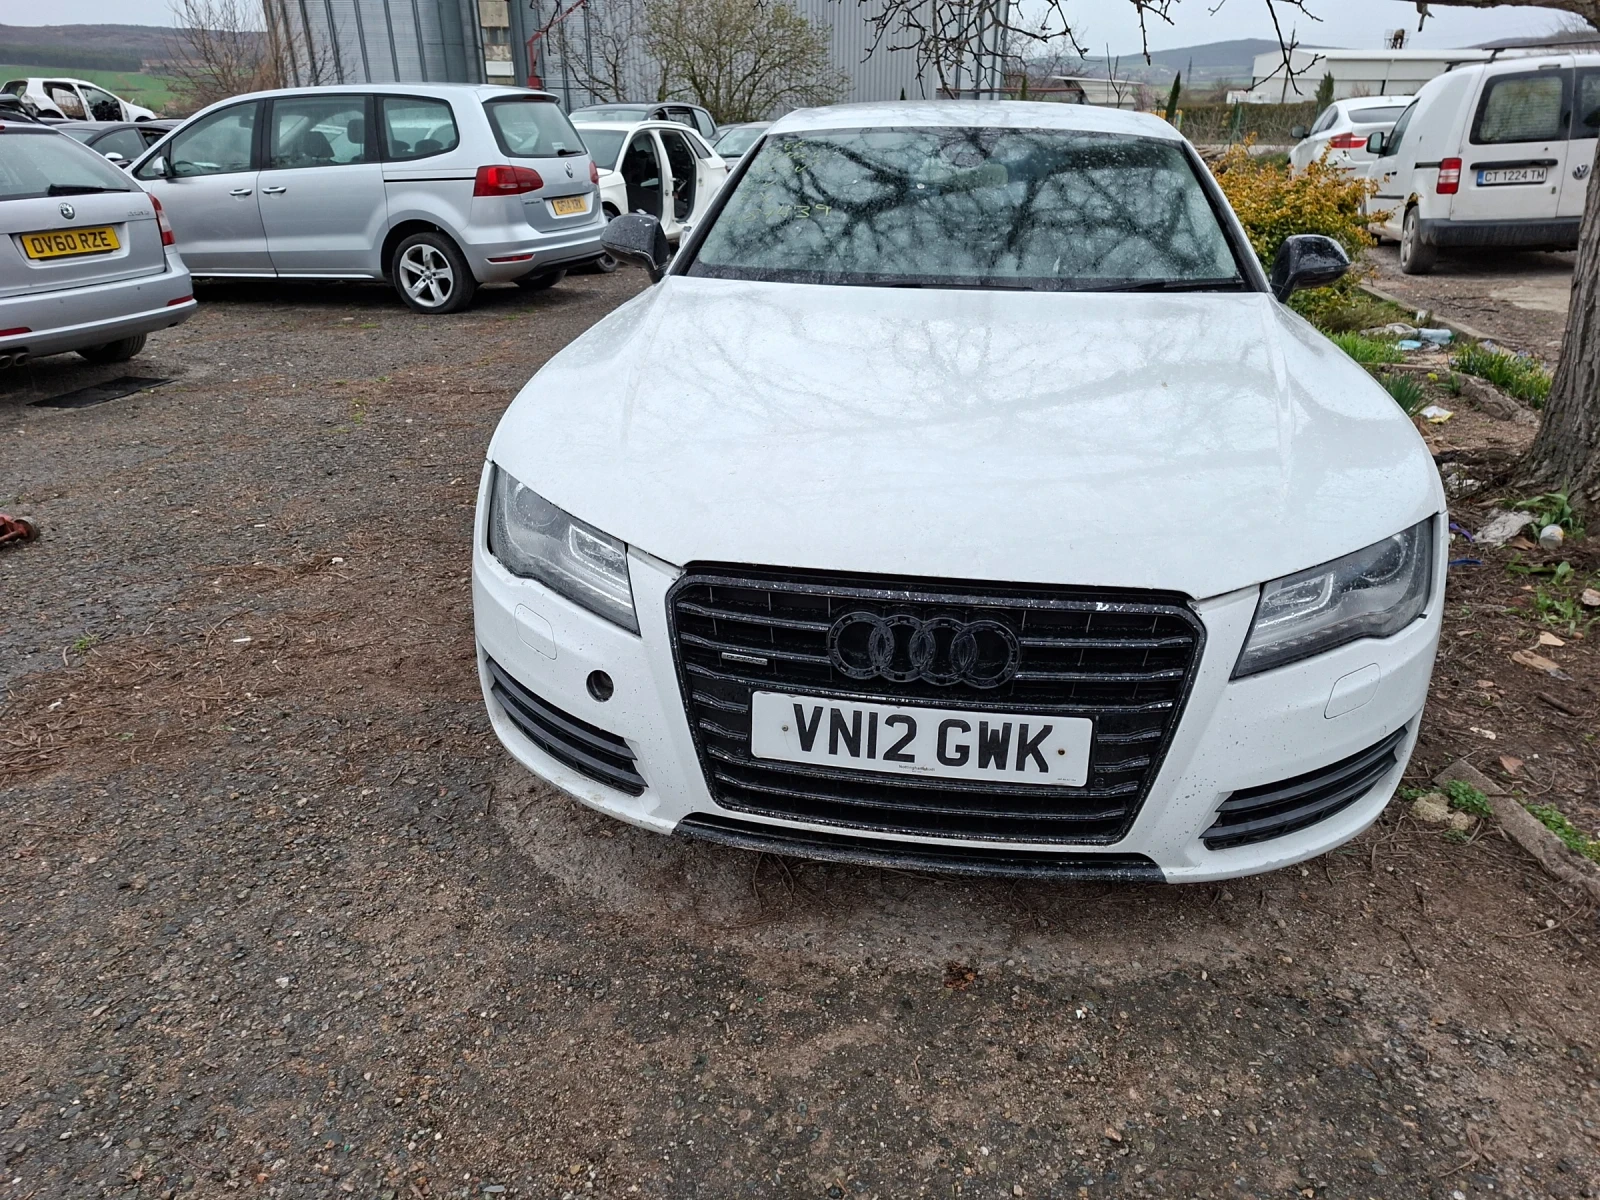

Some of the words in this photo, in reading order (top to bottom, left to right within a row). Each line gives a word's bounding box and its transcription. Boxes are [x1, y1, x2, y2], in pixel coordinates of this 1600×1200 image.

[1484, 171, 1499, 182] CT
[1503, 169, 1528, 181] 1224
[1530, 168, 1545, 180] TM
[31, 234, 77, 254] OV60
[78, 231, 111, 249] RZE
[793, 703, 917, 763] VN12
[936, 718, 1053, 773] GWK
